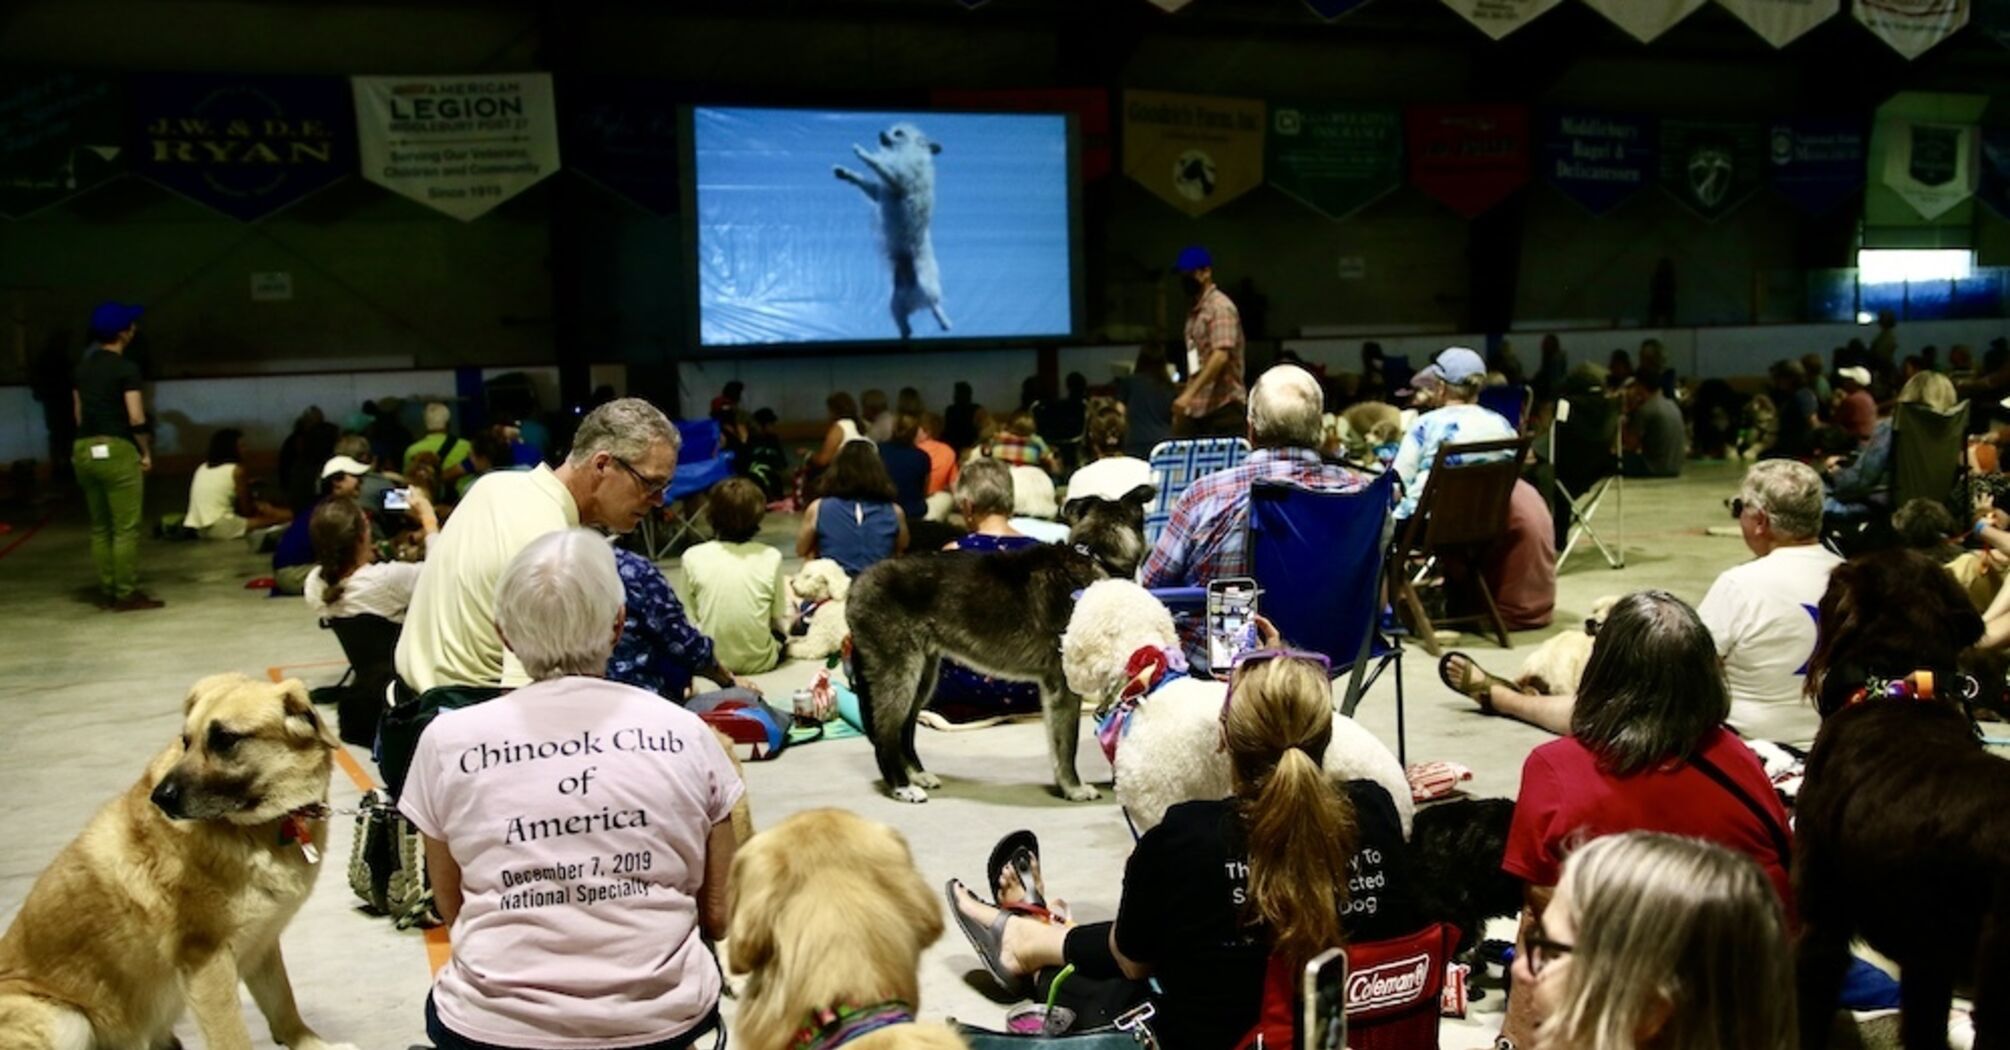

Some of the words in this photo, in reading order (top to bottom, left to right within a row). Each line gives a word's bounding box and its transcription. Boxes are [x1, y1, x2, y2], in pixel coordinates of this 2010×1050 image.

[427, 82, 520, 95] AMERICAN
[390, 96, 523, 120] LEGION
[148, 117, 216, 136] J.W.
[226, 119, 250, 137] &
[264, 119, 335, 138] D.E.
[1560, 116, 1639, 142] Middlebury
[152, 140, 331, 163] RYAN
[390, 151, 440, 164] Serving
[443, 149, 468, 161] Our
[1572, 138, 1610, 162] Bagel
[383, 165, 439, 178] Children
[442, 164, 468, 176] and
[469, 162, 540, 175] Community
[1555, 158, 1641, 182] Delicatessen
[428, 186, 466, 199] Since
[459, 731, 603, 774] Chinook
[613, 727, 684, 754] Club
[558, 766, 597, 795] of
[504, 806, 649, 845] America
[1361, 848, 1381, 864] To
[502, 862, 584, 888] December
[612, 850, 652, 875] 2019
[500, 885, 570, 911] National
[576, 876, 650, 906] Specialty
[1338, 896, 1377, 915] Dog
[1350, 970, 1417, 1003] Coleman
